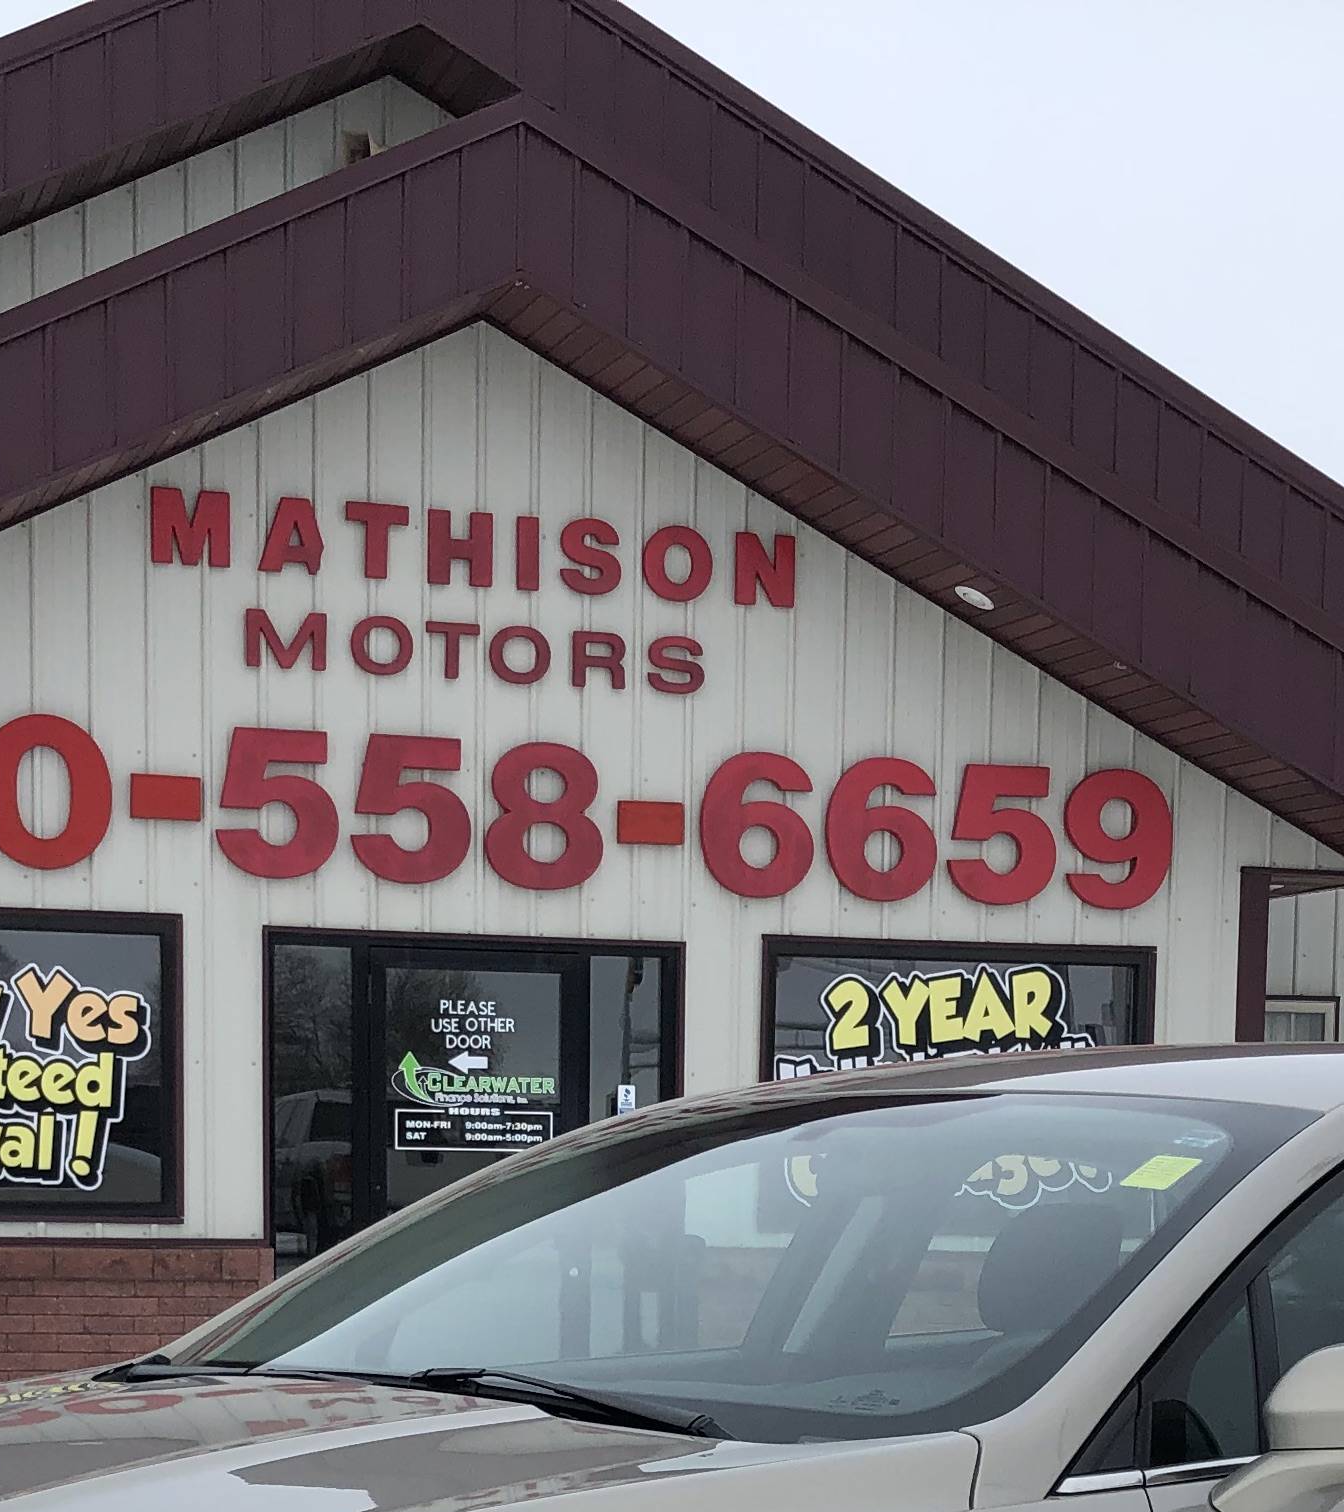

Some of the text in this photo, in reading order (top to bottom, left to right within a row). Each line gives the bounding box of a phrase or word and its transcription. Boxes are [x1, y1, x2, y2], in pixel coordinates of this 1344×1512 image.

[150, 486, 796, 608] MATHISON
[244, 608, 706, 694] MOTORS
[15, 966, 141, 1047] Yes
[439, 999, 497, 1016] PLEASE
[826, 969, 1055, 1052] 2 YEAR
[430, 1017, 515, 1033] USE OTHER
[445, 1034, 492, 1049] DOOR
[427, 1072, 555, 1094] CLEARWATER
[448, 1107, 501, 1116] HOURS
[405, 1119, 452, 1130] MON-FRI
[405, 1131, 427, 1140] SAT
